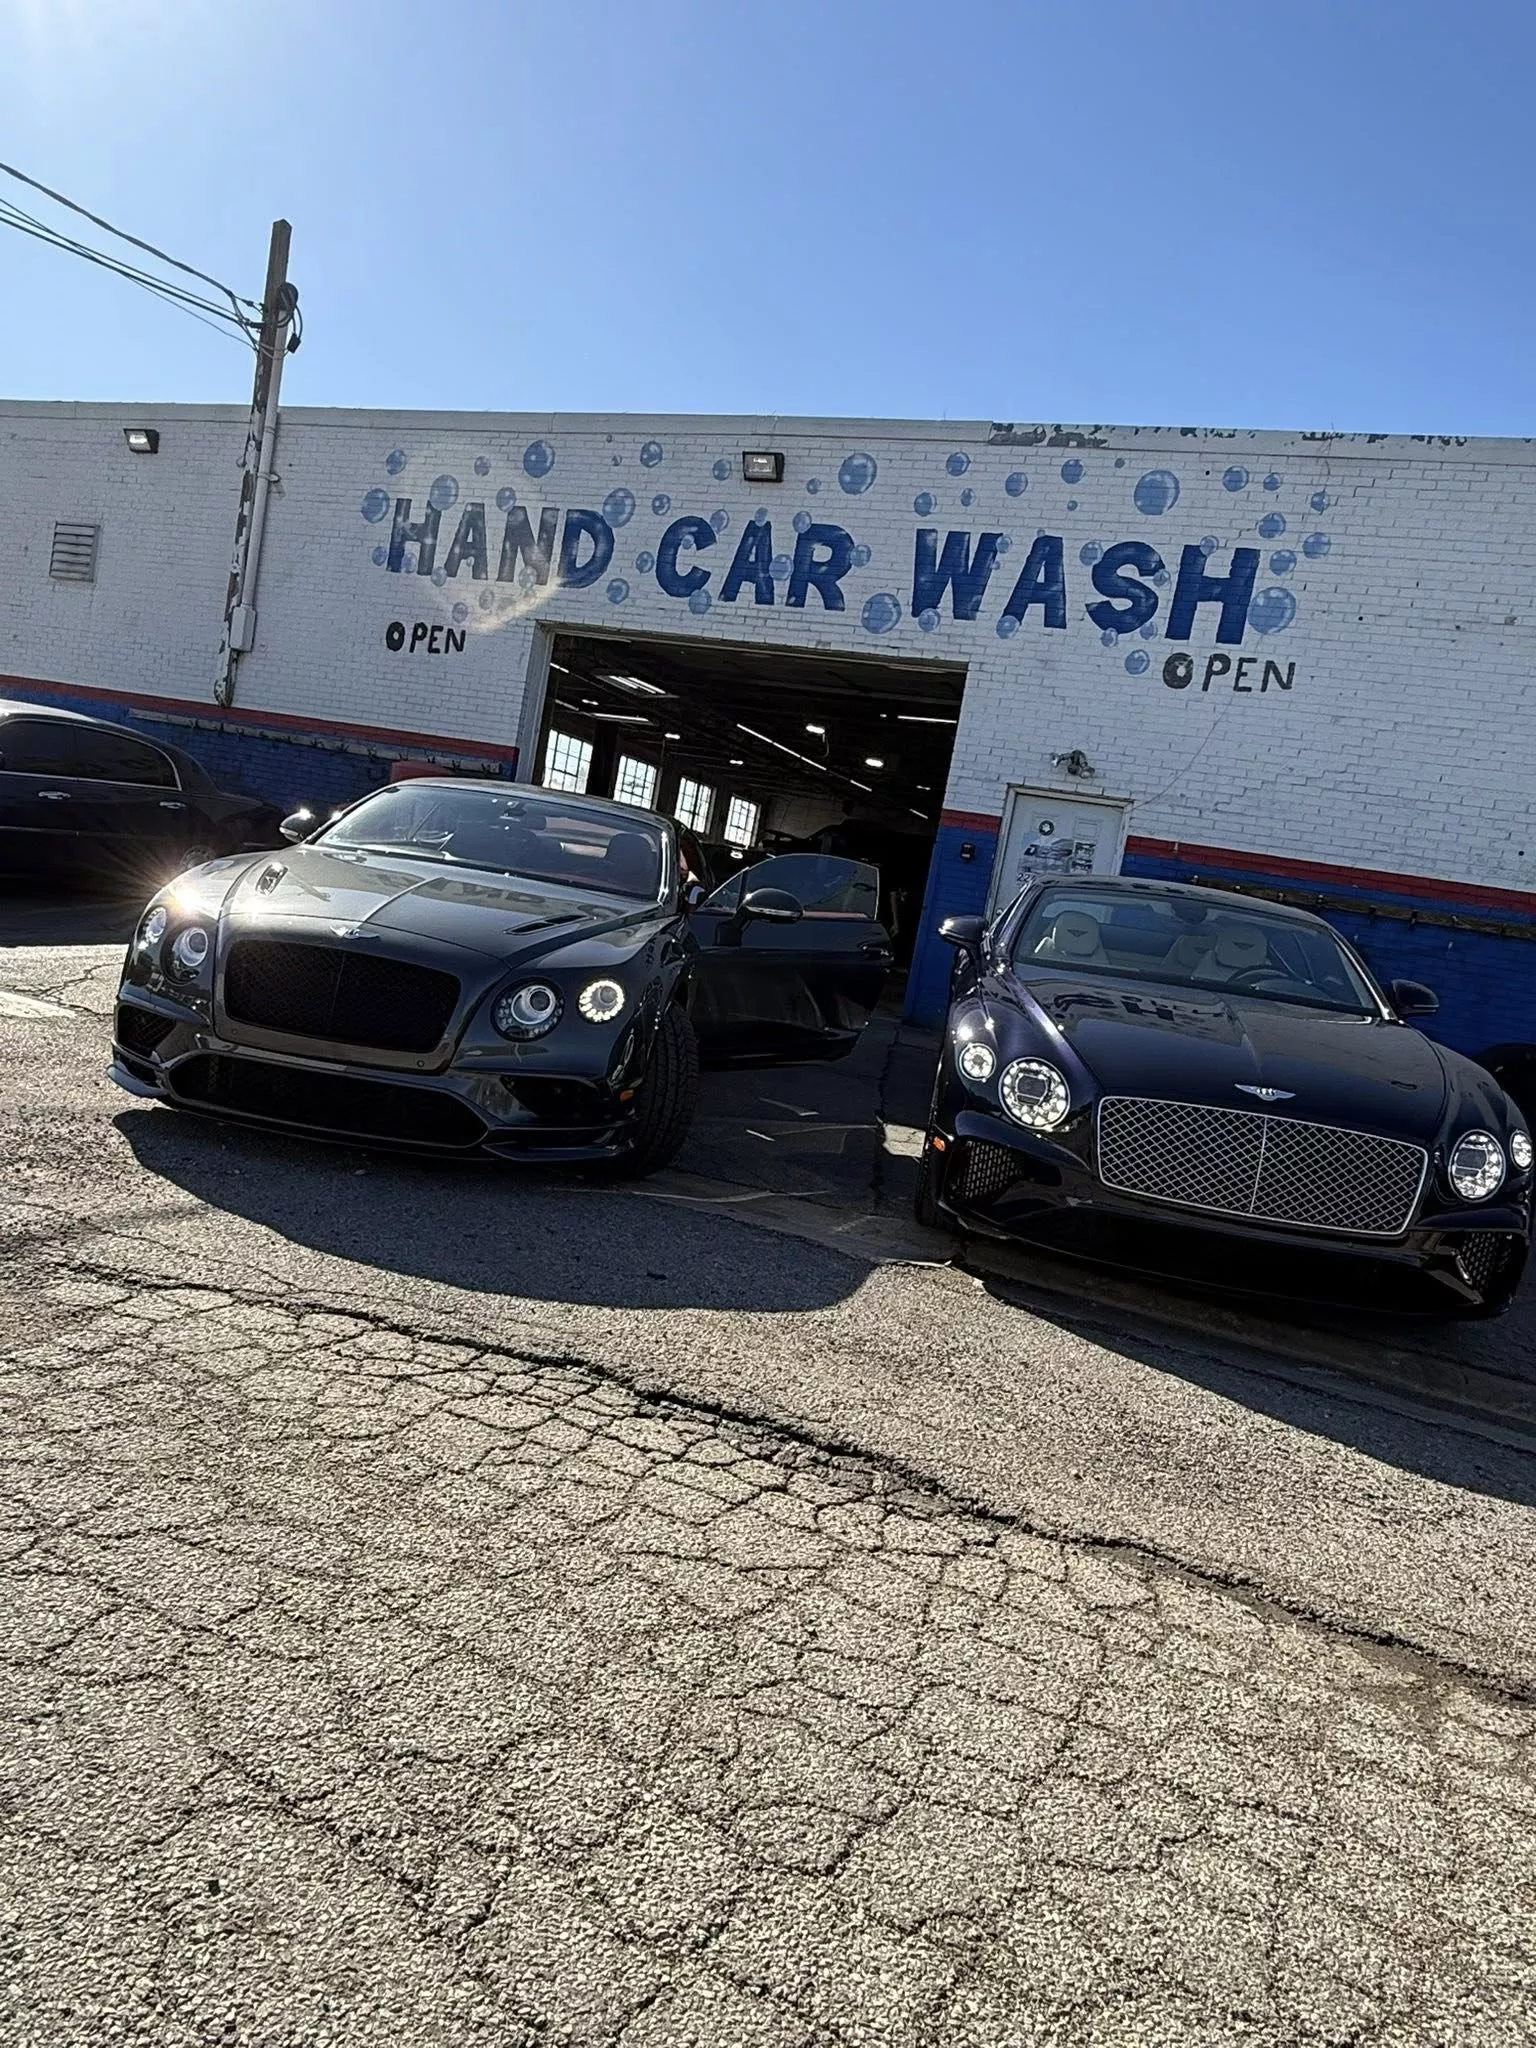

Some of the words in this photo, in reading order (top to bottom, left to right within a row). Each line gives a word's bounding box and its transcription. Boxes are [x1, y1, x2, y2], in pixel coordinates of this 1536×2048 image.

[386, 497, 615, 589] HAND
[655, 515, 857, 612] CAR
[911, 528, 1261, 645] WASH
[386, 621, 467, 654] OPEN
[1162, 652, 1296, 693] OPEN
